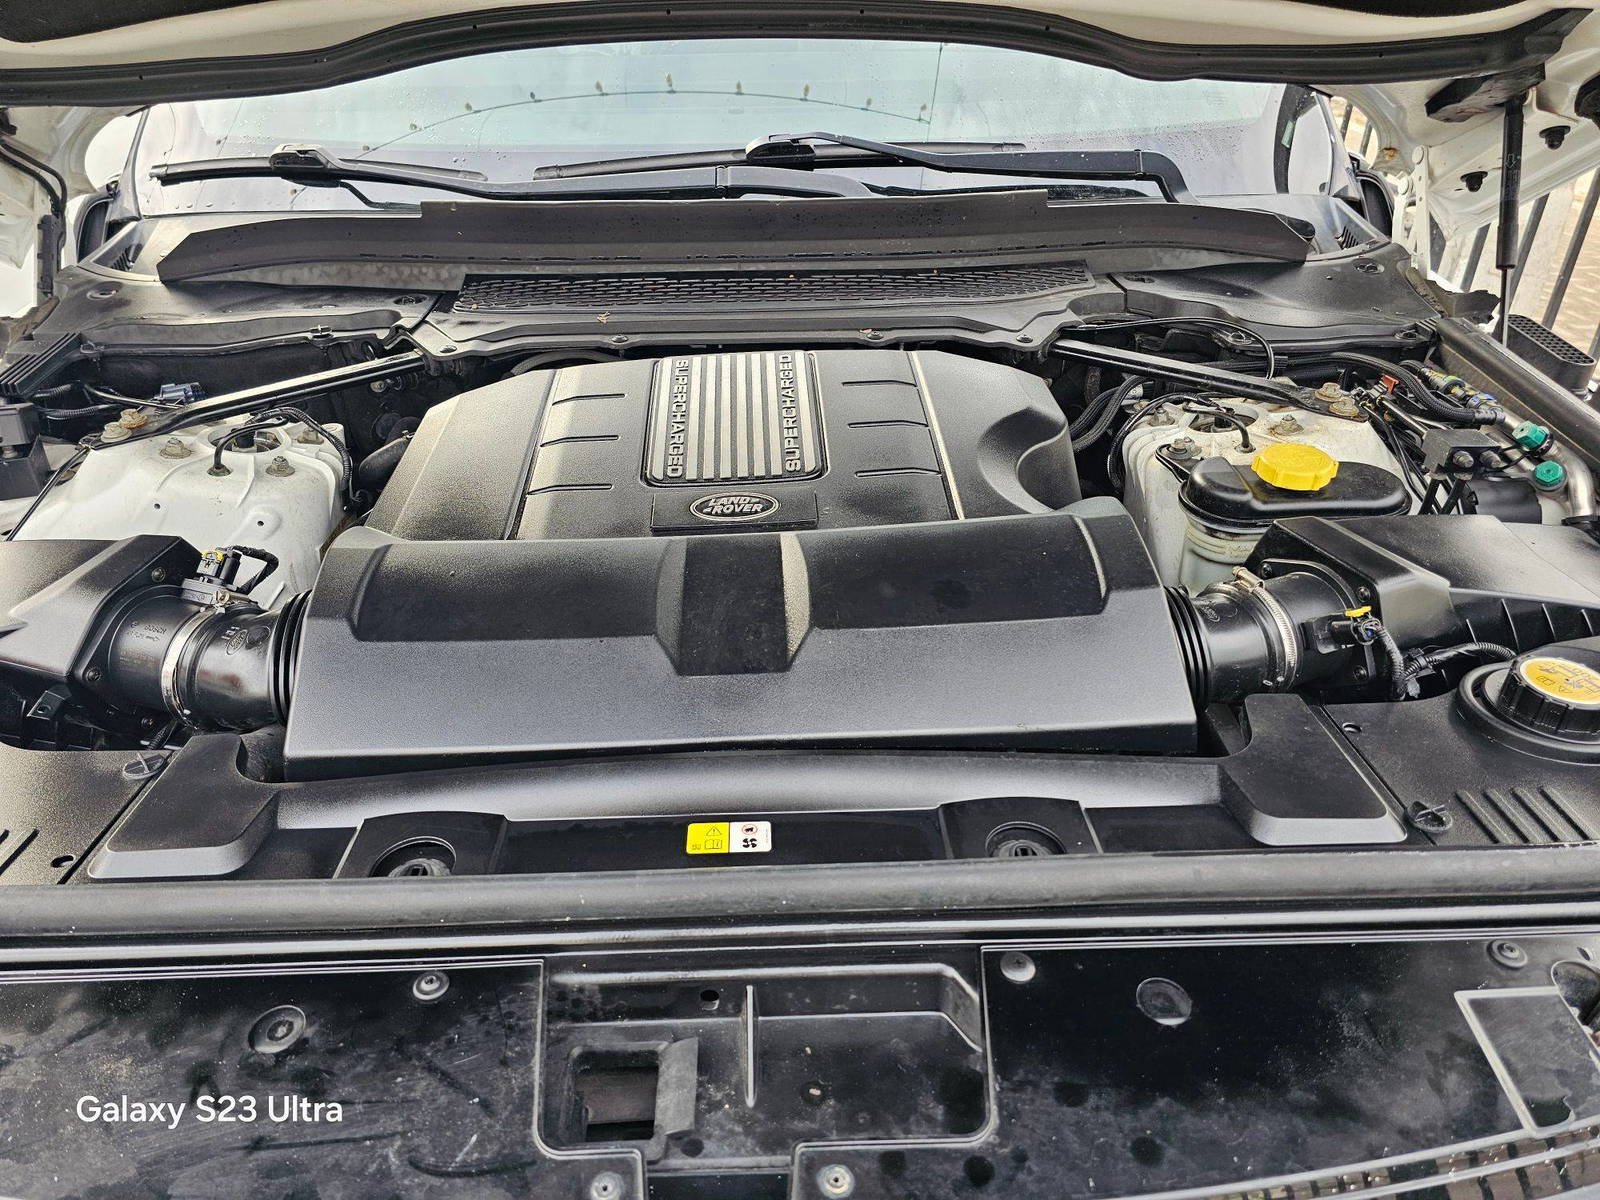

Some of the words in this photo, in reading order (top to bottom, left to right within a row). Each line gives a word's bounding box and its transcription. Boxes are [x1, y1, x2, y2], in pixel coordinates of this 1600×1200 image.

[666, 359, 689, 478] SUPERCHARGED
[779, 353, 801, 472] SUPERCHARGED
[708, 496, 750, 507] LAND
[711, 503, 763, 514] ROVER
